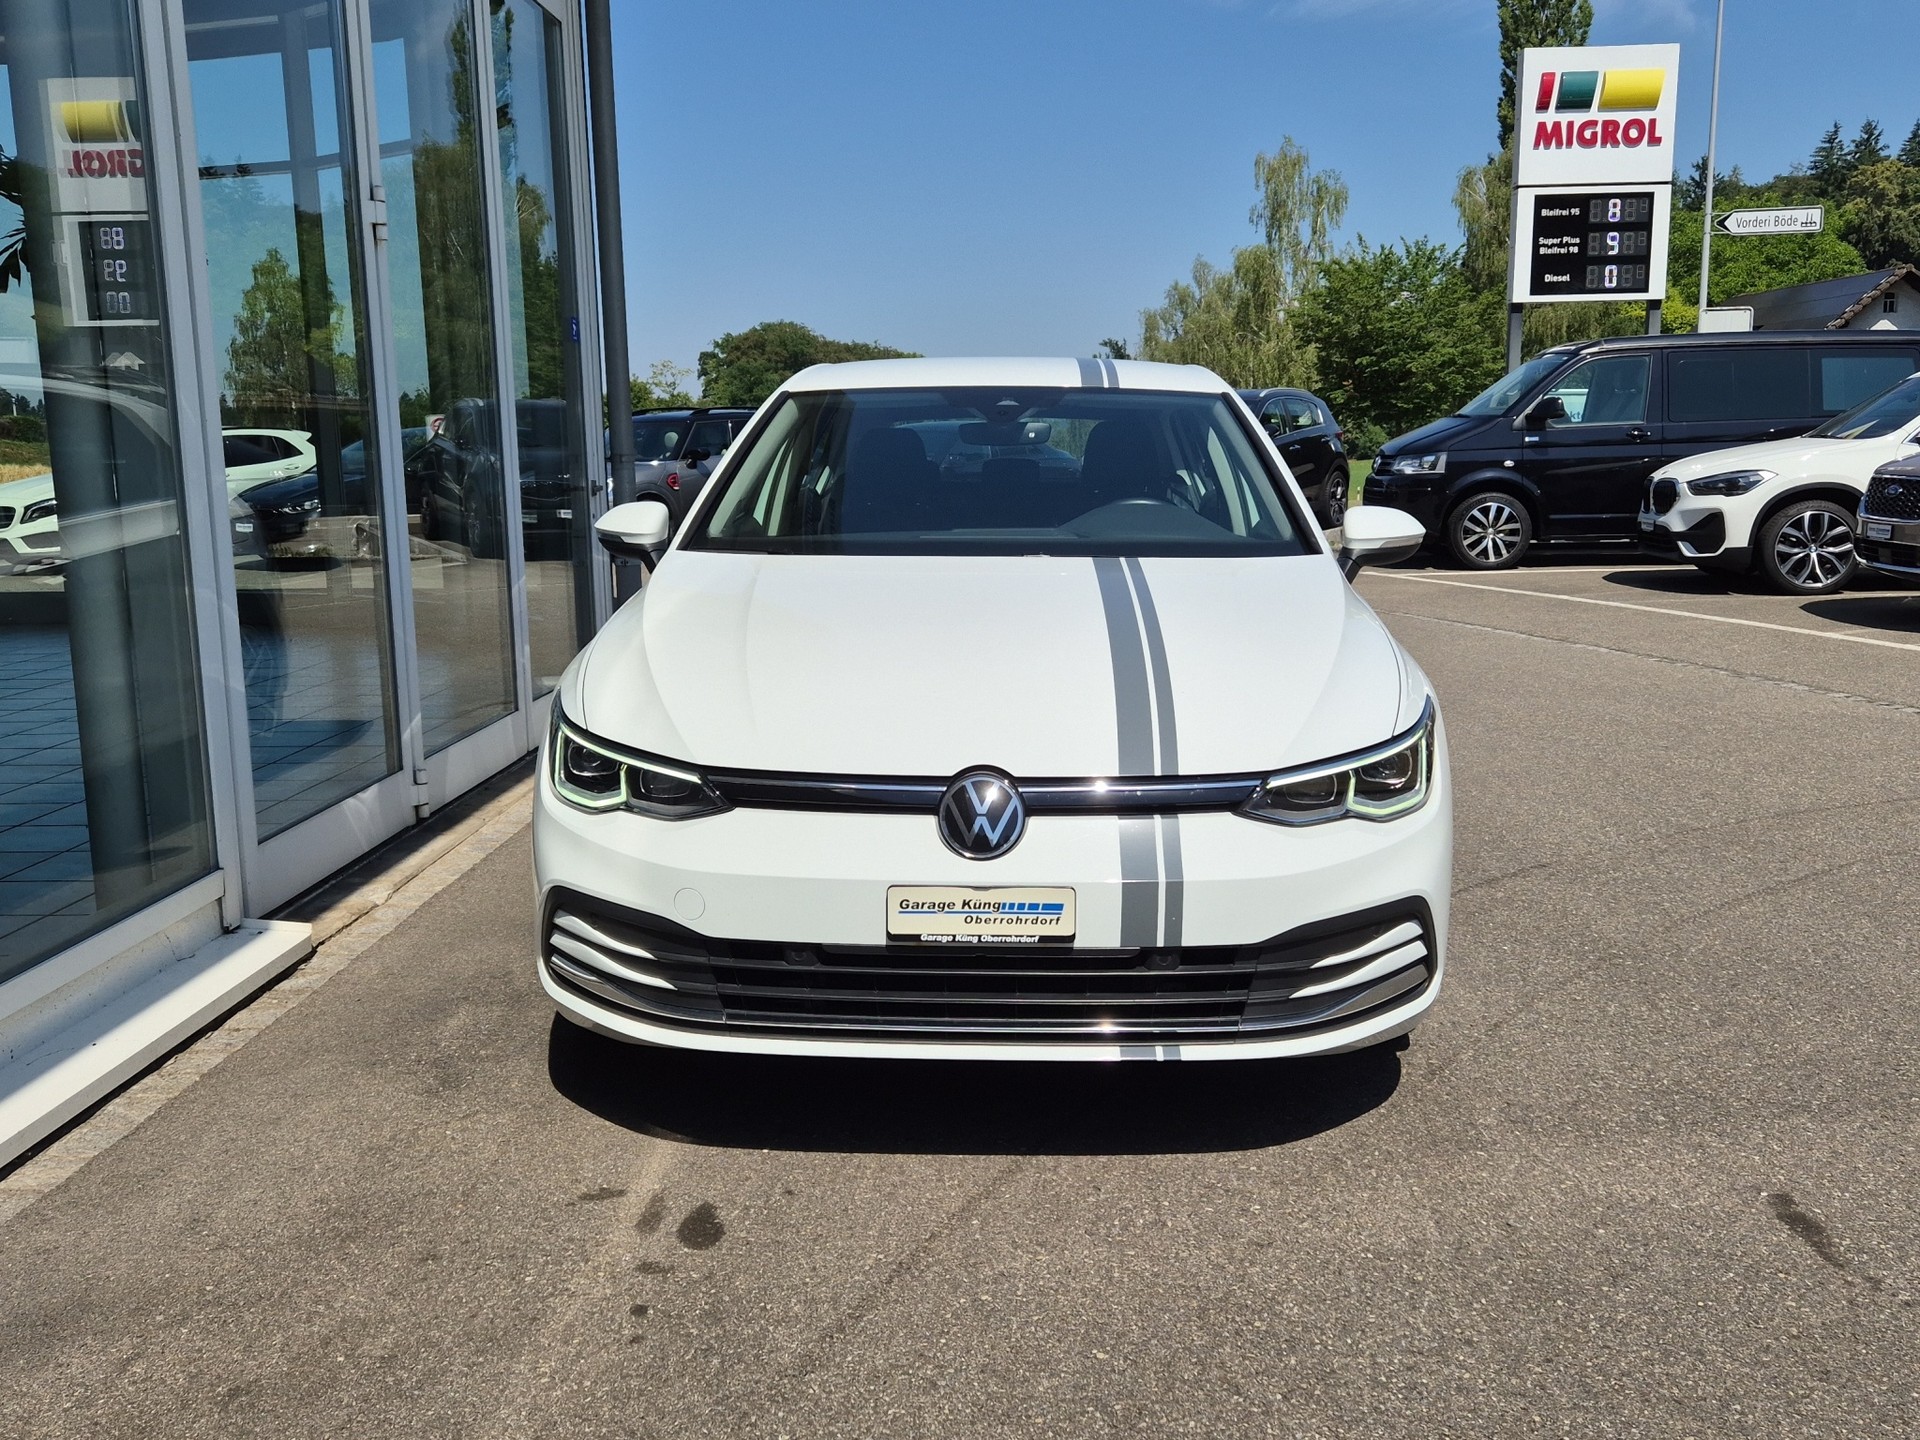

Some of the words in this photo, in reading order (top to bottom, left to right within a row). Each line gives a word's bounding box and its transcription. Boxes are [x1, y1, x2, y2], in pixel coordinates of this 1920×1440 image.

[1533, 118, 1662, 149] MIGROL
[1541, 208, 1569, 217] Bleifrei
[1570, 207, 1580, 216] 95
[1736, 215, 1771, 229] Vorderi
[1774, 214, 1798, 227] Böde
[1538, 236, 1562, 246] Super
[1562, 236, 1580, 244] Plus
[1539, 246, 1568, 254] Bleifrei
[1568, 246, 1579, 254] 98
[1544, 273, 1570, 282] Diesel
[899, 899, 956, 912] Garage
[961, 899, 1002, 912] Küng
[964, 915, 1061, 926] Oberrohrdorf
[920, 933, 954, 943] Garage
[955, 933, 979, 943] Küng
[980, 934, 1040, 943] Oberrohrdorf
